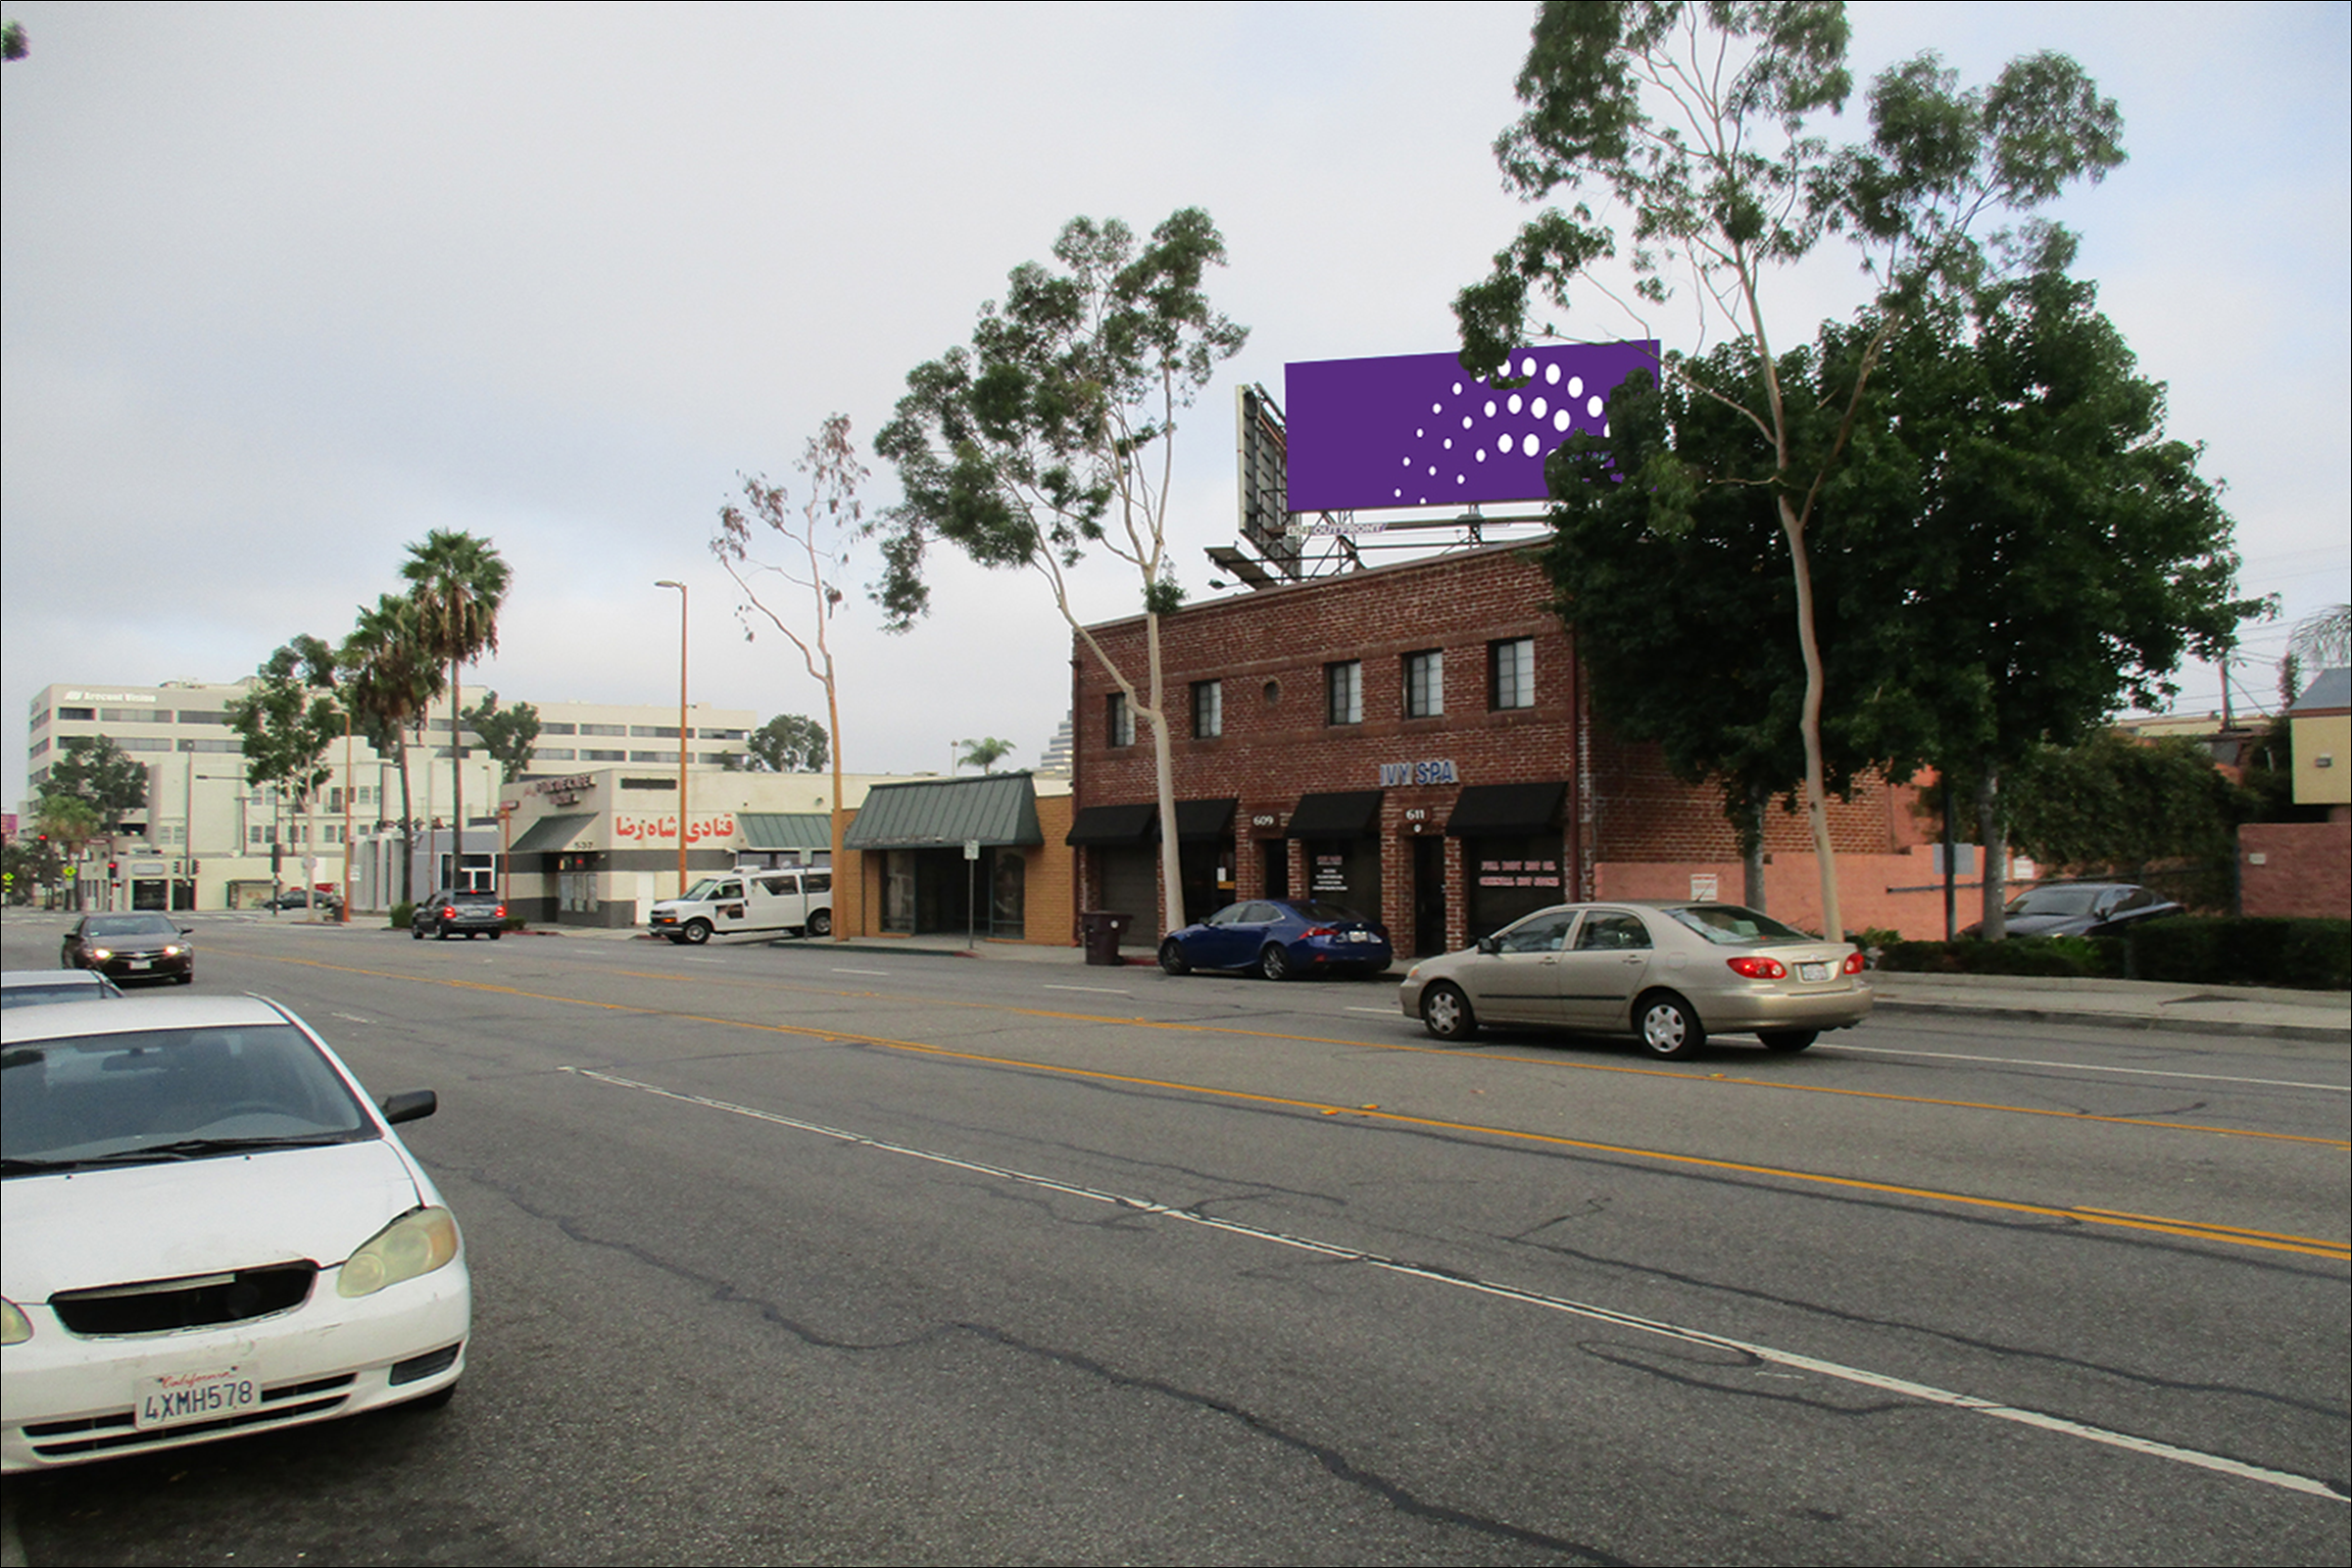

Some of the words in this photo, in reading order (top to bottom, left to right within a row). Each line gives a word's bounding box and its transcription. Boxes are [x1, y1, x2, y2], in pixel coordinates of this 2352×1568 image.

[1313, 523, 1383, 535] OUTFRONT
[1380, 763, 1412, 787] IVY
[1415, 760, 1457, 785] SPA
[1252, 815, 1274, 826] 609
[1405, 808, 1426, 821] 611
[685, 812, 734, 844] قنادی
[162, 1370, 231, 1389] California
[144, 1379, 253, 1422] 4XMH578
